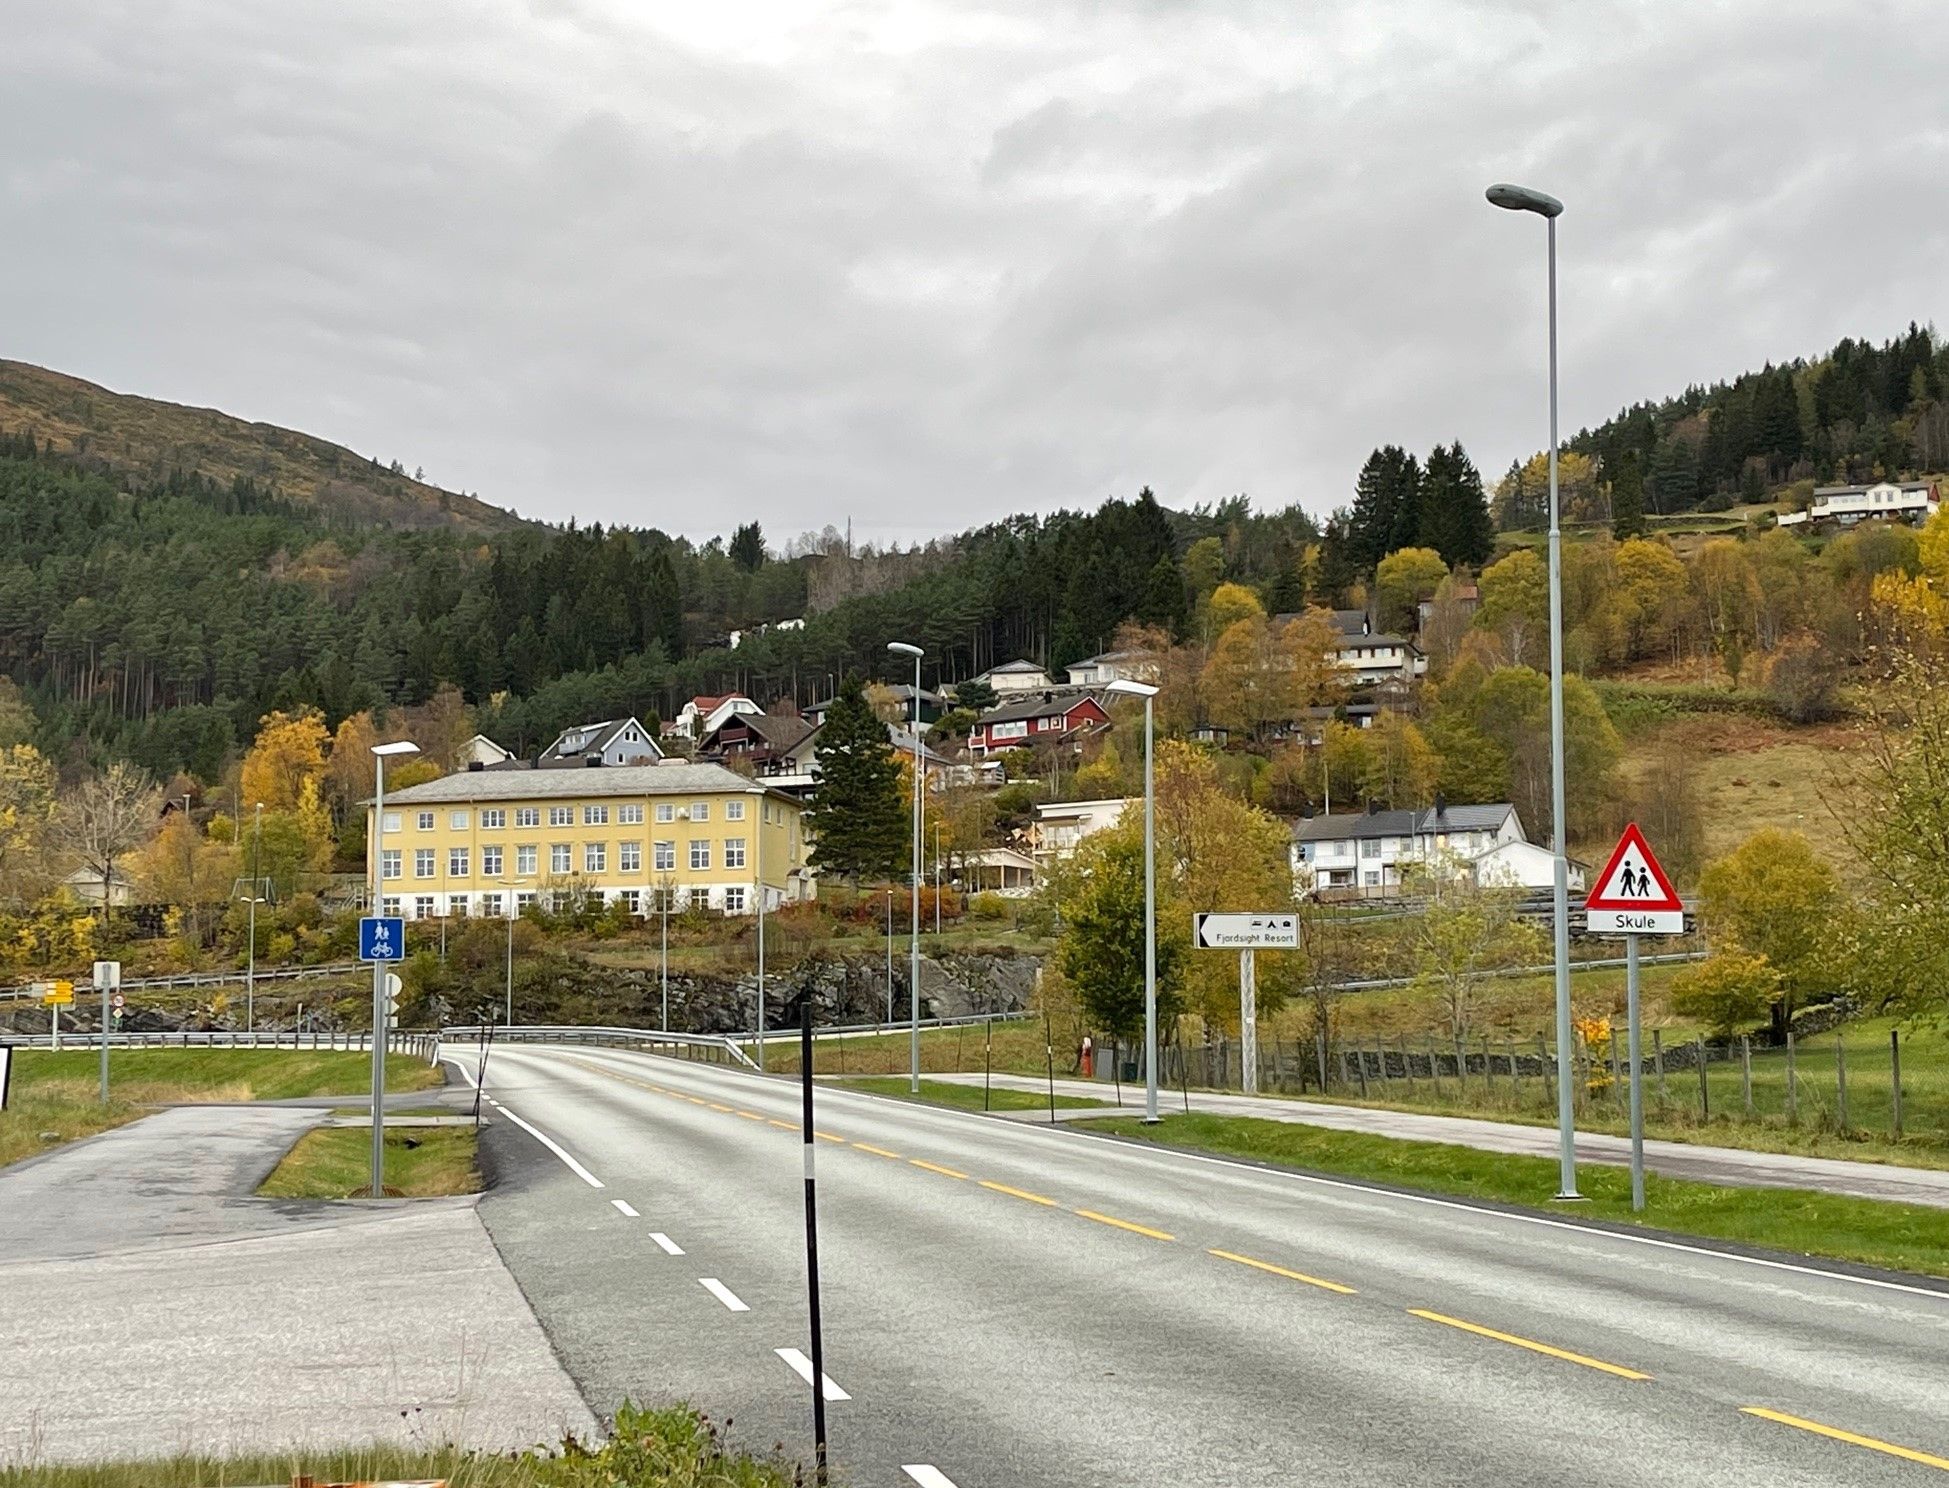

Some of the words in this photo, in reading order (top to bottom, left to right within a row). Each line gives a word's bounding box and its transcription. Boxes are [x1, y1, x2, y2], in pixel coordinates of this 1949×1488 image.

[1616, 915, 1655, 928] Skule
[1216, 933, 1260, 944] Fjordsight
[1264, 934, 1294, 942] Resort
